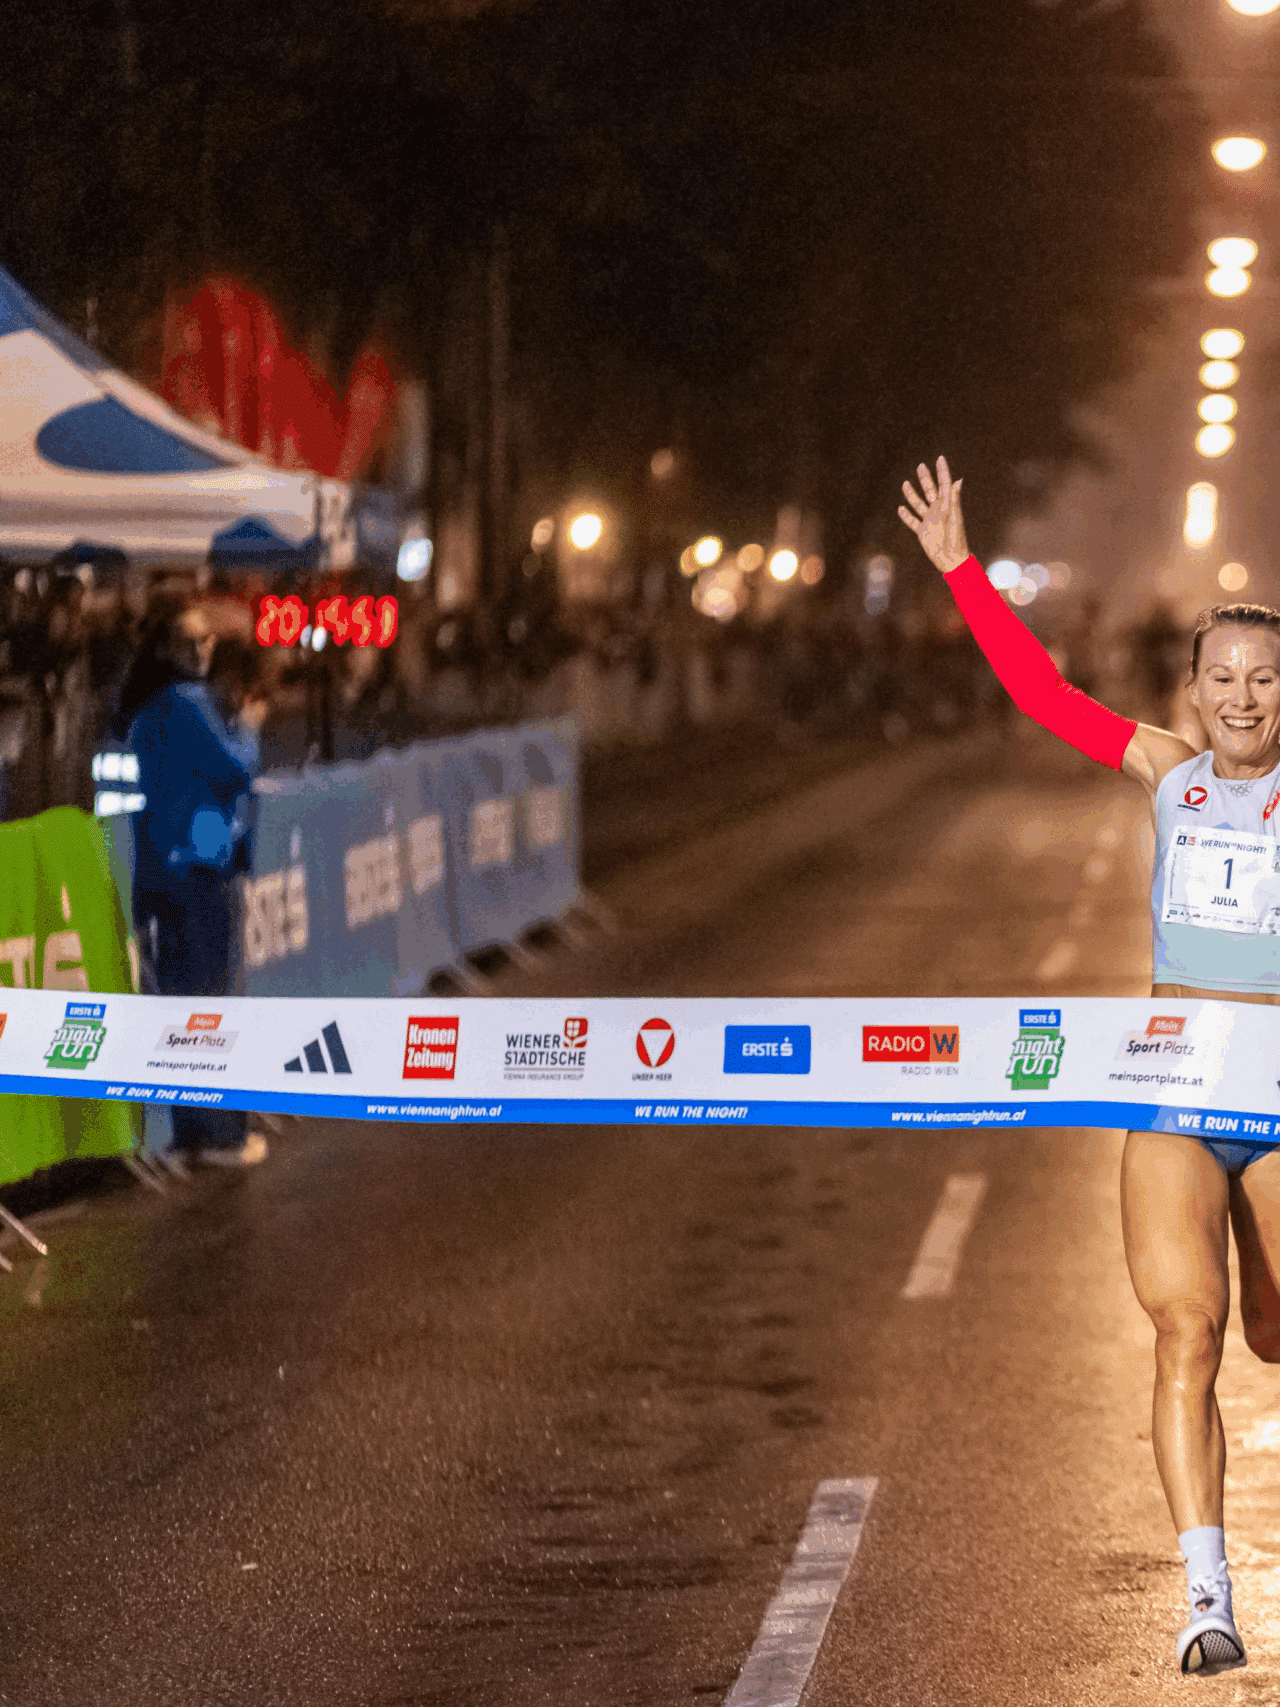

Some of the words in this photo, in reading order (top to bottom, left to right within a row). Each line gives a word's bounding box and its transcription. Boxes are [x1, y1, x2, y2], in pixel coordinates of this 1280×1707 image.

[1236, 842, 1267, 854] NIGHT!
[1224, 858, 1234, 889] 1
[1211, 895, 1238, 908] JULIA
[54, 1024, 103, 1047] night
[166, 1033, 198, 1048] Sport
[200, 1034, 226, 1047] Platz
[408, 1024, 457, 1045] Kronen
[506, 1033, 561, 1048] WIENER
[44, 1040, 97, 1059] run
[742, 1042, 779, 1057] ERSTE
[867, 1035, 925, 1052] RADIO
[932, 1033, 957, 1054] W
[1014, 1035, 1061, 1059] night
[1126, 1039, 1161, 1056] Sport
[1162, 1041, 1195, 1055] Platz
[406, 1047, 454, 1071] Zeitung
[504, 1051, 586, 1066] STÄDTISCHE
[1006, 1055, 1058, 1075] run
[901, 1066, 931, 1075] RADIO
[934, 1066, 959, 1075] WIEN
[1107, 1071, 1204, 1086] meinsportplatz.at
[105, 1085, 126, 1096] WE
[126, 1087, 154, 1098] RUN
[155, 1089, 179, 1100] THE
[179, 1091, 223, 1103] NIGHT!
[366, 1103, 502, 1120] www.viennanightrun.at
[634, 1105, 653, 1118] WE
[654, 1105, 680, 1118] RUN
[682, 1106, 704, 1118] THE
[705, 1106, 748, 1119] NIGHT!
[892, 1109, 1026, 1125] www.viennanightrun.at
[1178, 1113, 1202, 1128] WE
[1204, 1116, 1239, 1132] RUN
[1243, 1119, 1271, 1135] THE
